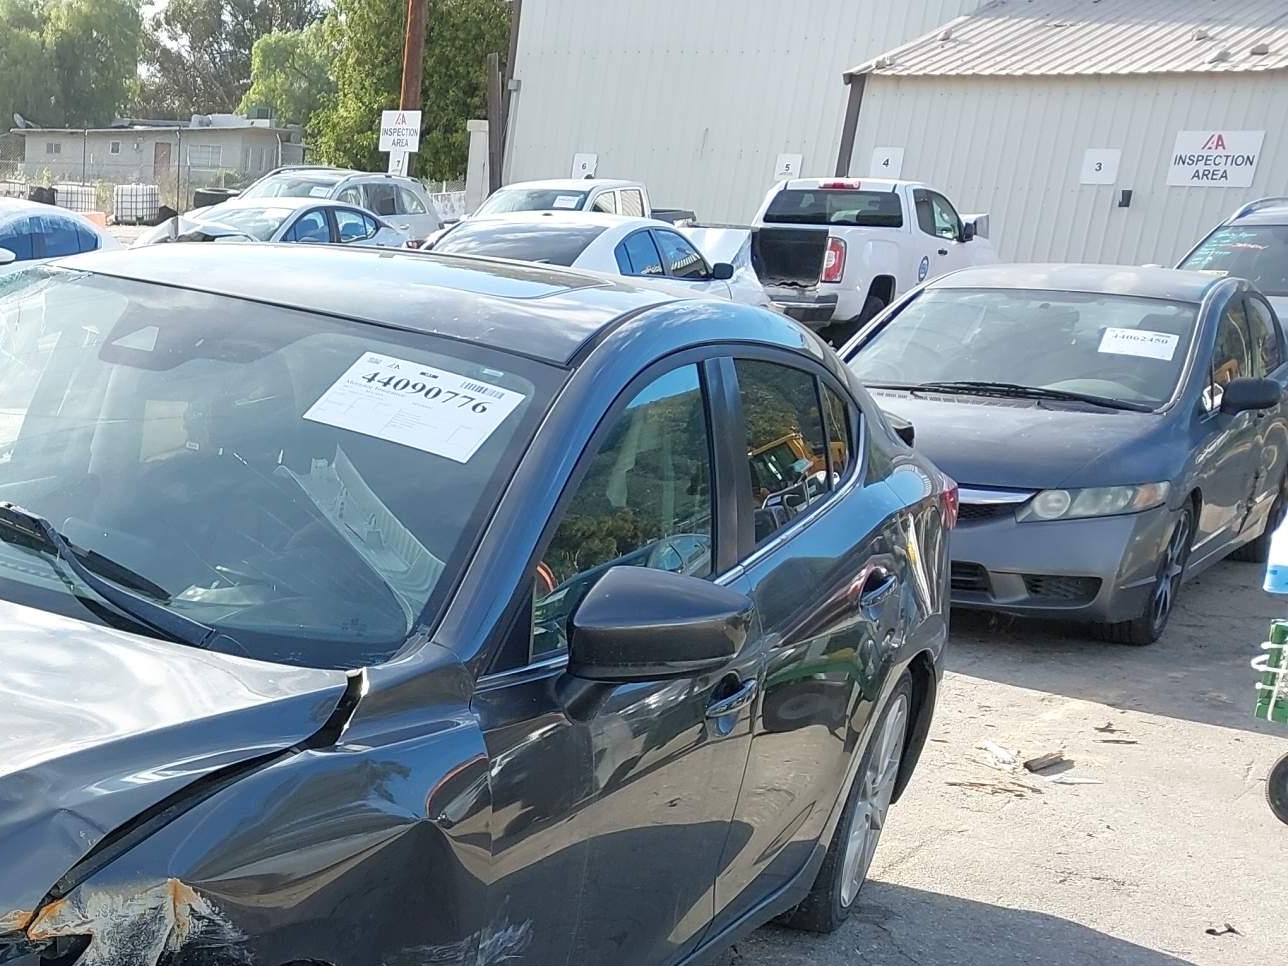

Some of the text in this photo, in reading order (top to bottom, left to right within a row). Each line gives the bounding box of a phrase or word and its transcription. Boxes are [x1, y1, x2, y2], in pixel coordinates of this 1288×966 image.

[381, 127, 419, 137] INSPECTION
[391, 139, 409, 147] AREA
[882, 158, 890, 167] 4
[1173, 154, 1256, 167] INSPECTION
[581, 162, 587, 170] 6
[784, 163, 791, 172] 5
[1095, 162, 1103, 172] 3
[1191, 169, 1229, 181] AREA
[361, 371, 493, 414] 44090776
